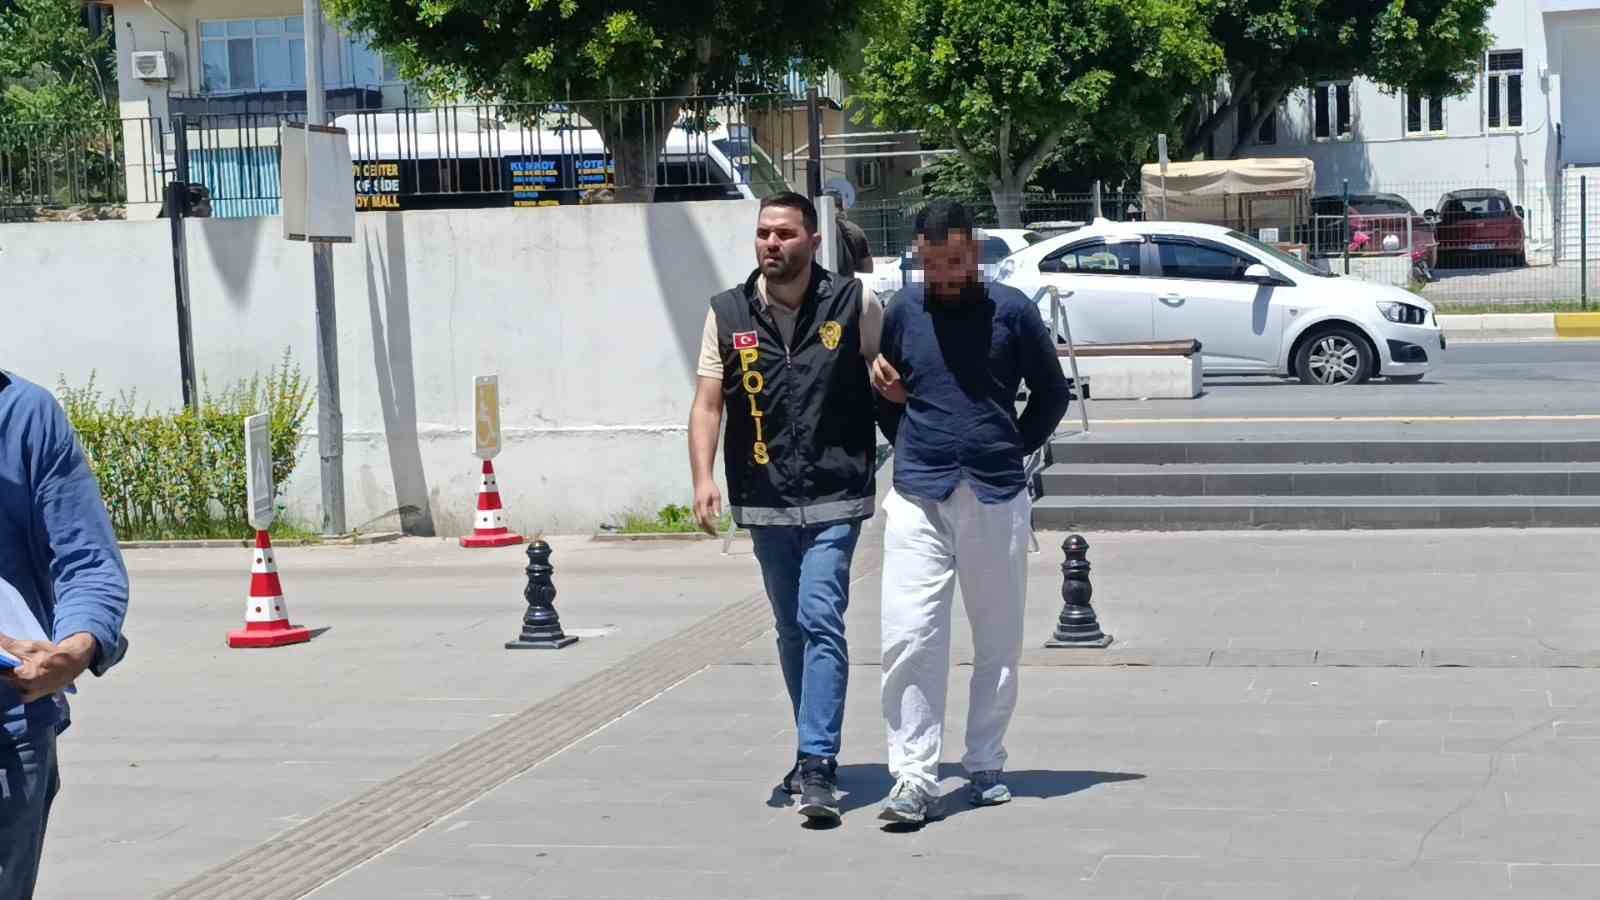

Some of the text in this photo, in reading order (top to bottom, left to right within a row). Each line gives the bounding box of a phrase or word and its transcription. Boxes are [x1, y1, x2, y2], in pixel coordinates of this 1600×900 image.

[363, 163, 399, 176] CENTER
[371, 195, 400, 208] MALL
[740, 348, 769, 464] POLIS
